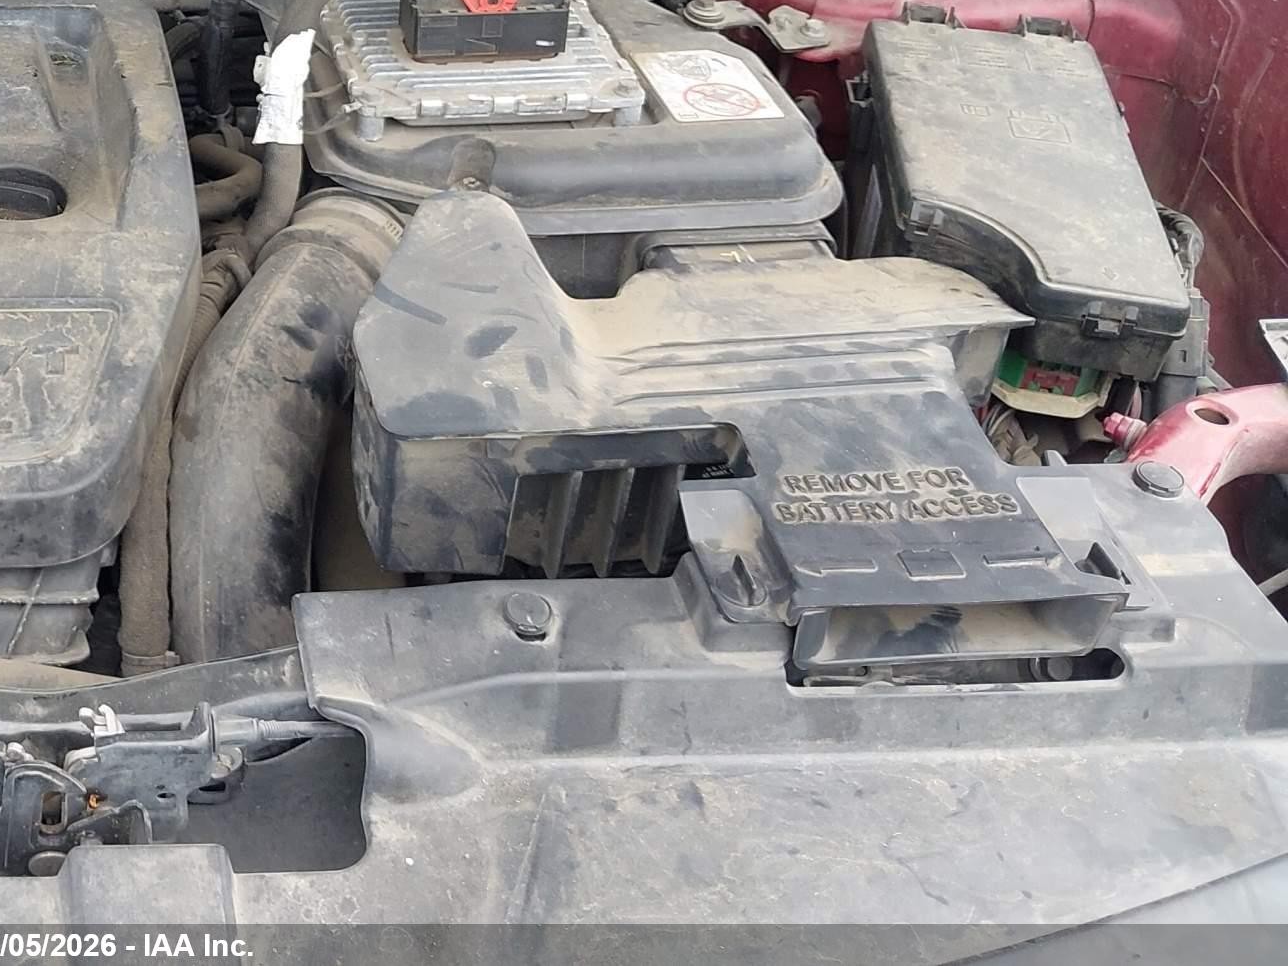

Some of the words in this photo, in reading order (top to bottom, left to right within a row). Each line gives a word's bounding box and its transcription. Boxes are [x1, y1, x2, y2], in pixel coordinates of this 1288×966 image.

[782, 471, 906, 495] REMOVE
[906, 466, 970, 490] FOR
[774, 499, 895, 523] BATTERY
[905, 493, 1019, 520] ACCESS
